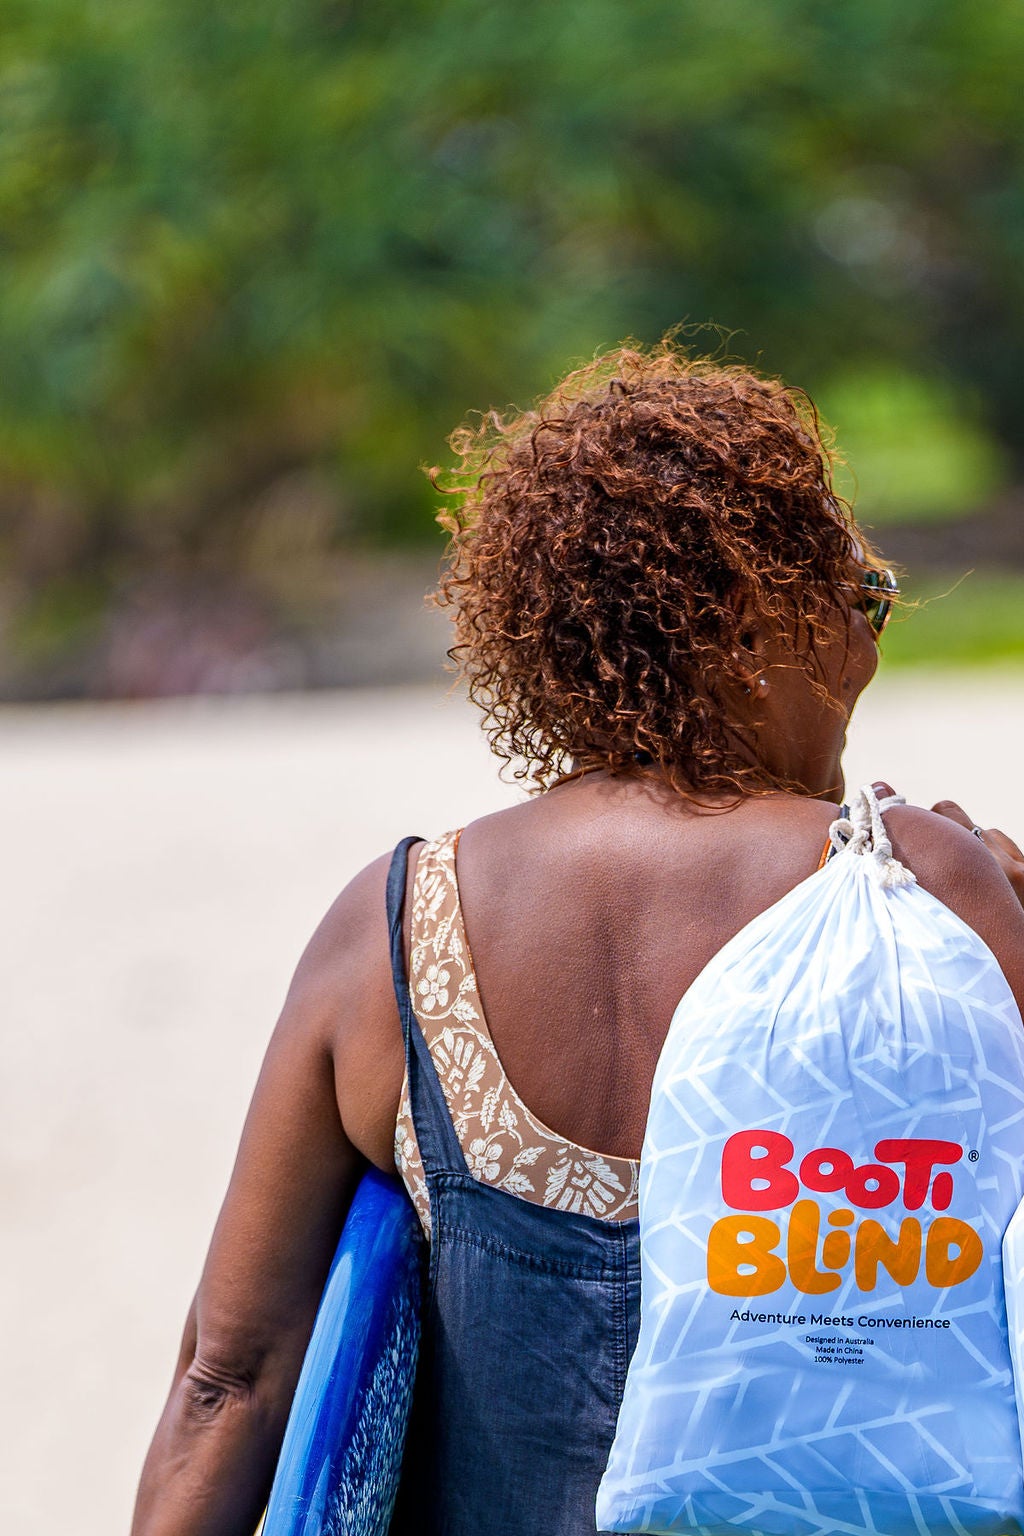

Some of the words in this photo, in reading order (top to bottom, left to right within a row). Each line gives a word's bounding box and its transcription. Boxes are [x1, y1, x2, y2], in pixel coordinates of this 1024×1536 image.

[730, 1309, 806, 1325] Adventure
[810, 1313, 854, 1327] Meets
[857, 1315, 951, 1329] Convenience
[805, 1336, 836, 1345] Designed
[845, 1337, 874, 1345] Australia
[815, 1346, 834, 1354] Made
[814, 1356, 832, 1364] 100%
[834, 1356, 865, 1366] Polyester
